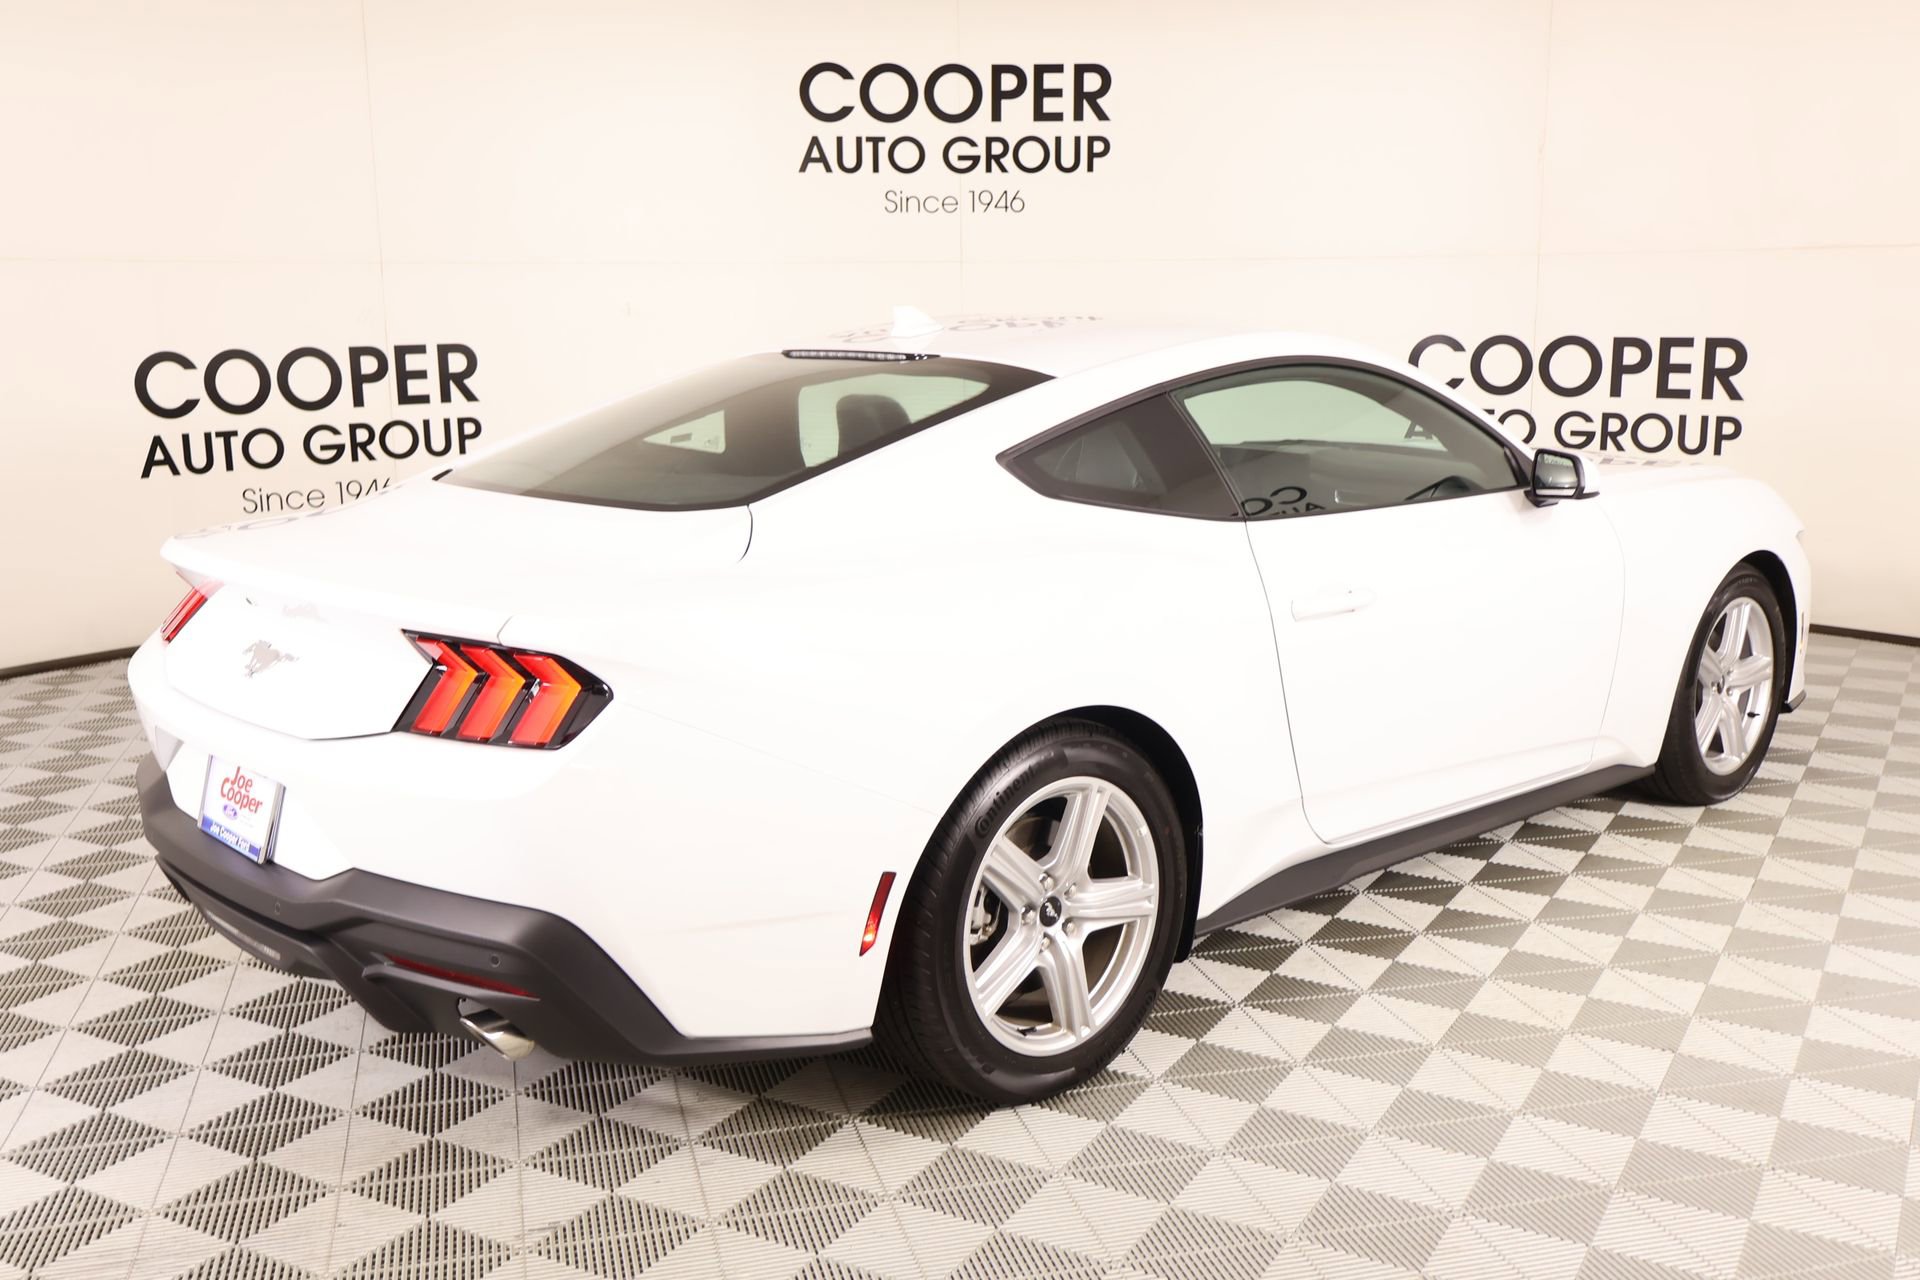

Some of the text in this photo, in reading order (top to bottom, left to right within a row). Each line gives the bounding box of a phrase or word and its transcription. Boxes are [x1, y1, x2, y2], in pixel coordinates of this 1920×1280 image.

[799, 62, 1112, 123] COOPER
[798, 136, 1111, 174] AUTO GROUP
[884, 190, 1026, 213] Since 1946
[134, 344, 480, 419] COOPER
[1408, 334, 1748, 401] COOPER
[140, 417, 482, 479] AUTO GROUP
[1554, 411, 1743, 456] GROUP
[242, 488, 326, 514] Since
[220, 777, 263, 814] Cooper
[231, 766, 253, 793] Joe
